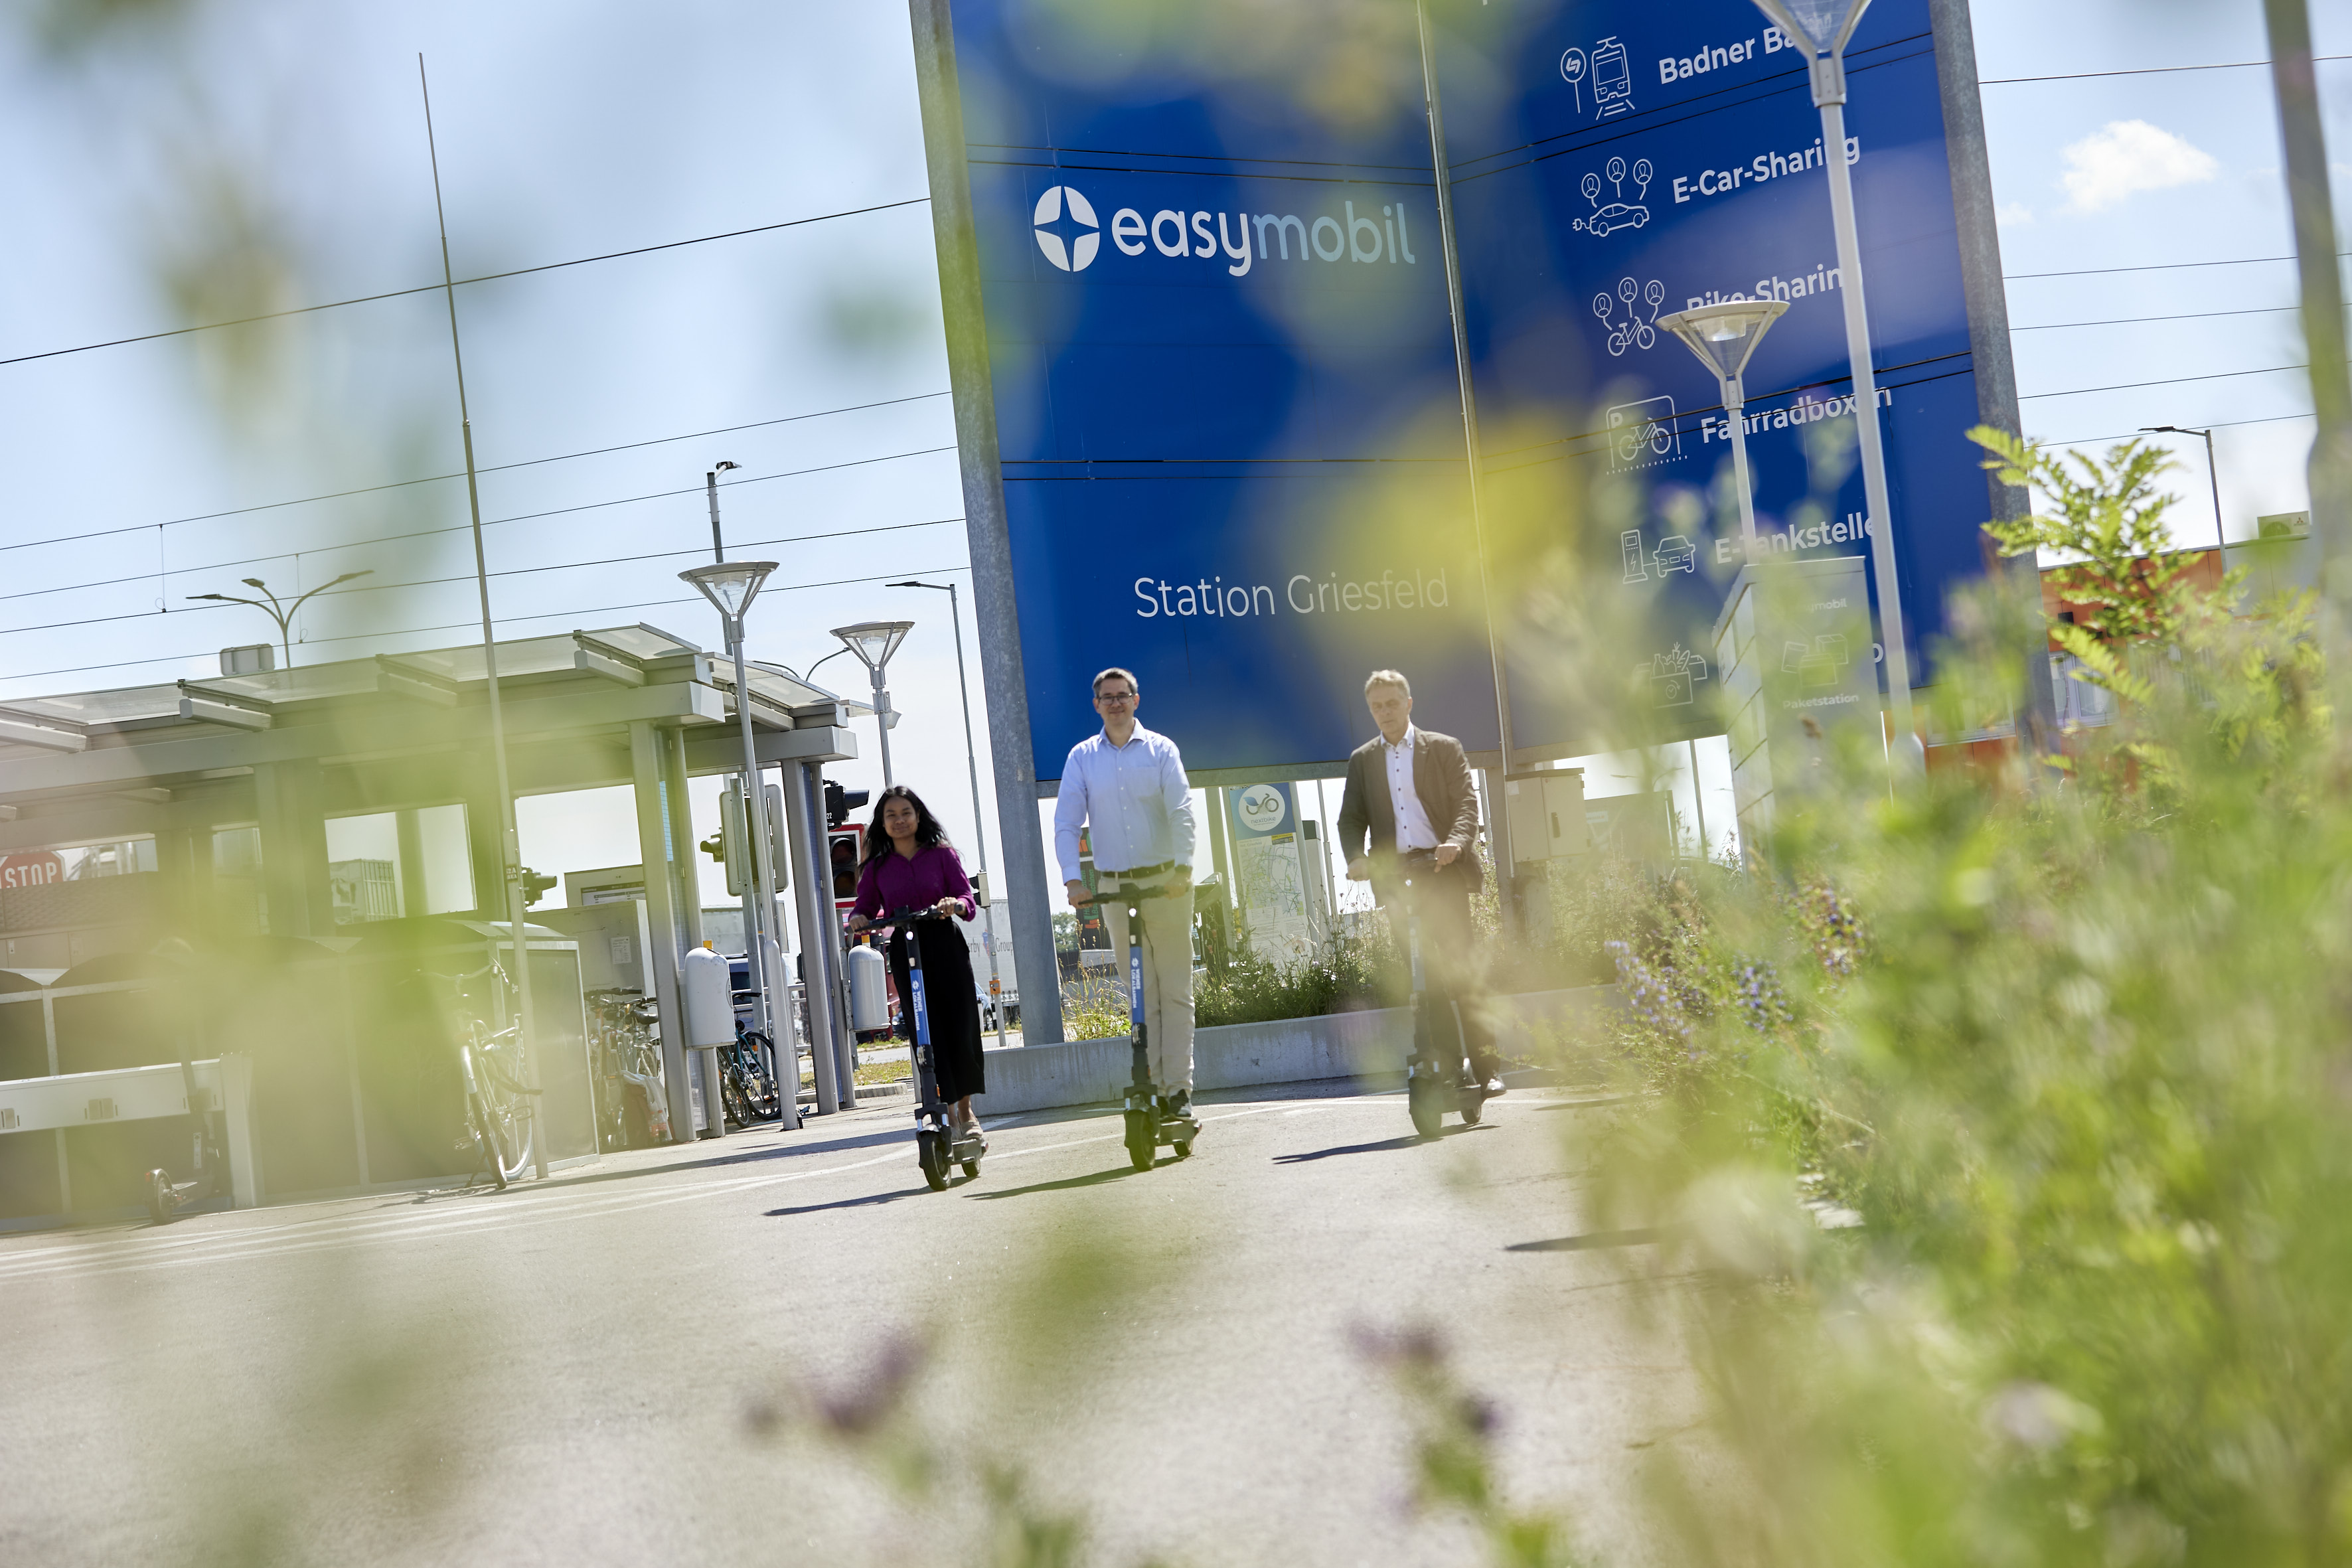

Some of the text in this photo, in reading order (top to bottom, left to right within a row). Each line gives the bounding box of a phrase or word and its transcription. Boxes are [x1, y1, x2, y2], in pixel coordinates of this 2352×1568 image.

[1659, 37, 1755, 84] Badner
[1672, 136, 1860, 204] E-Car-Sharig
[1111, 200, 1415, 277] easymobil
[1701, 386, 1892, 443] Farradboxn
[1134, 568, 1449, 617] Station Griesfeld
[1782, 694, 1859, 710] Paketstation
[1251, 816, 1277, 824] nextbike
[5, 862, 57, 888] STOP
[967, 937, 980, 957] erby
